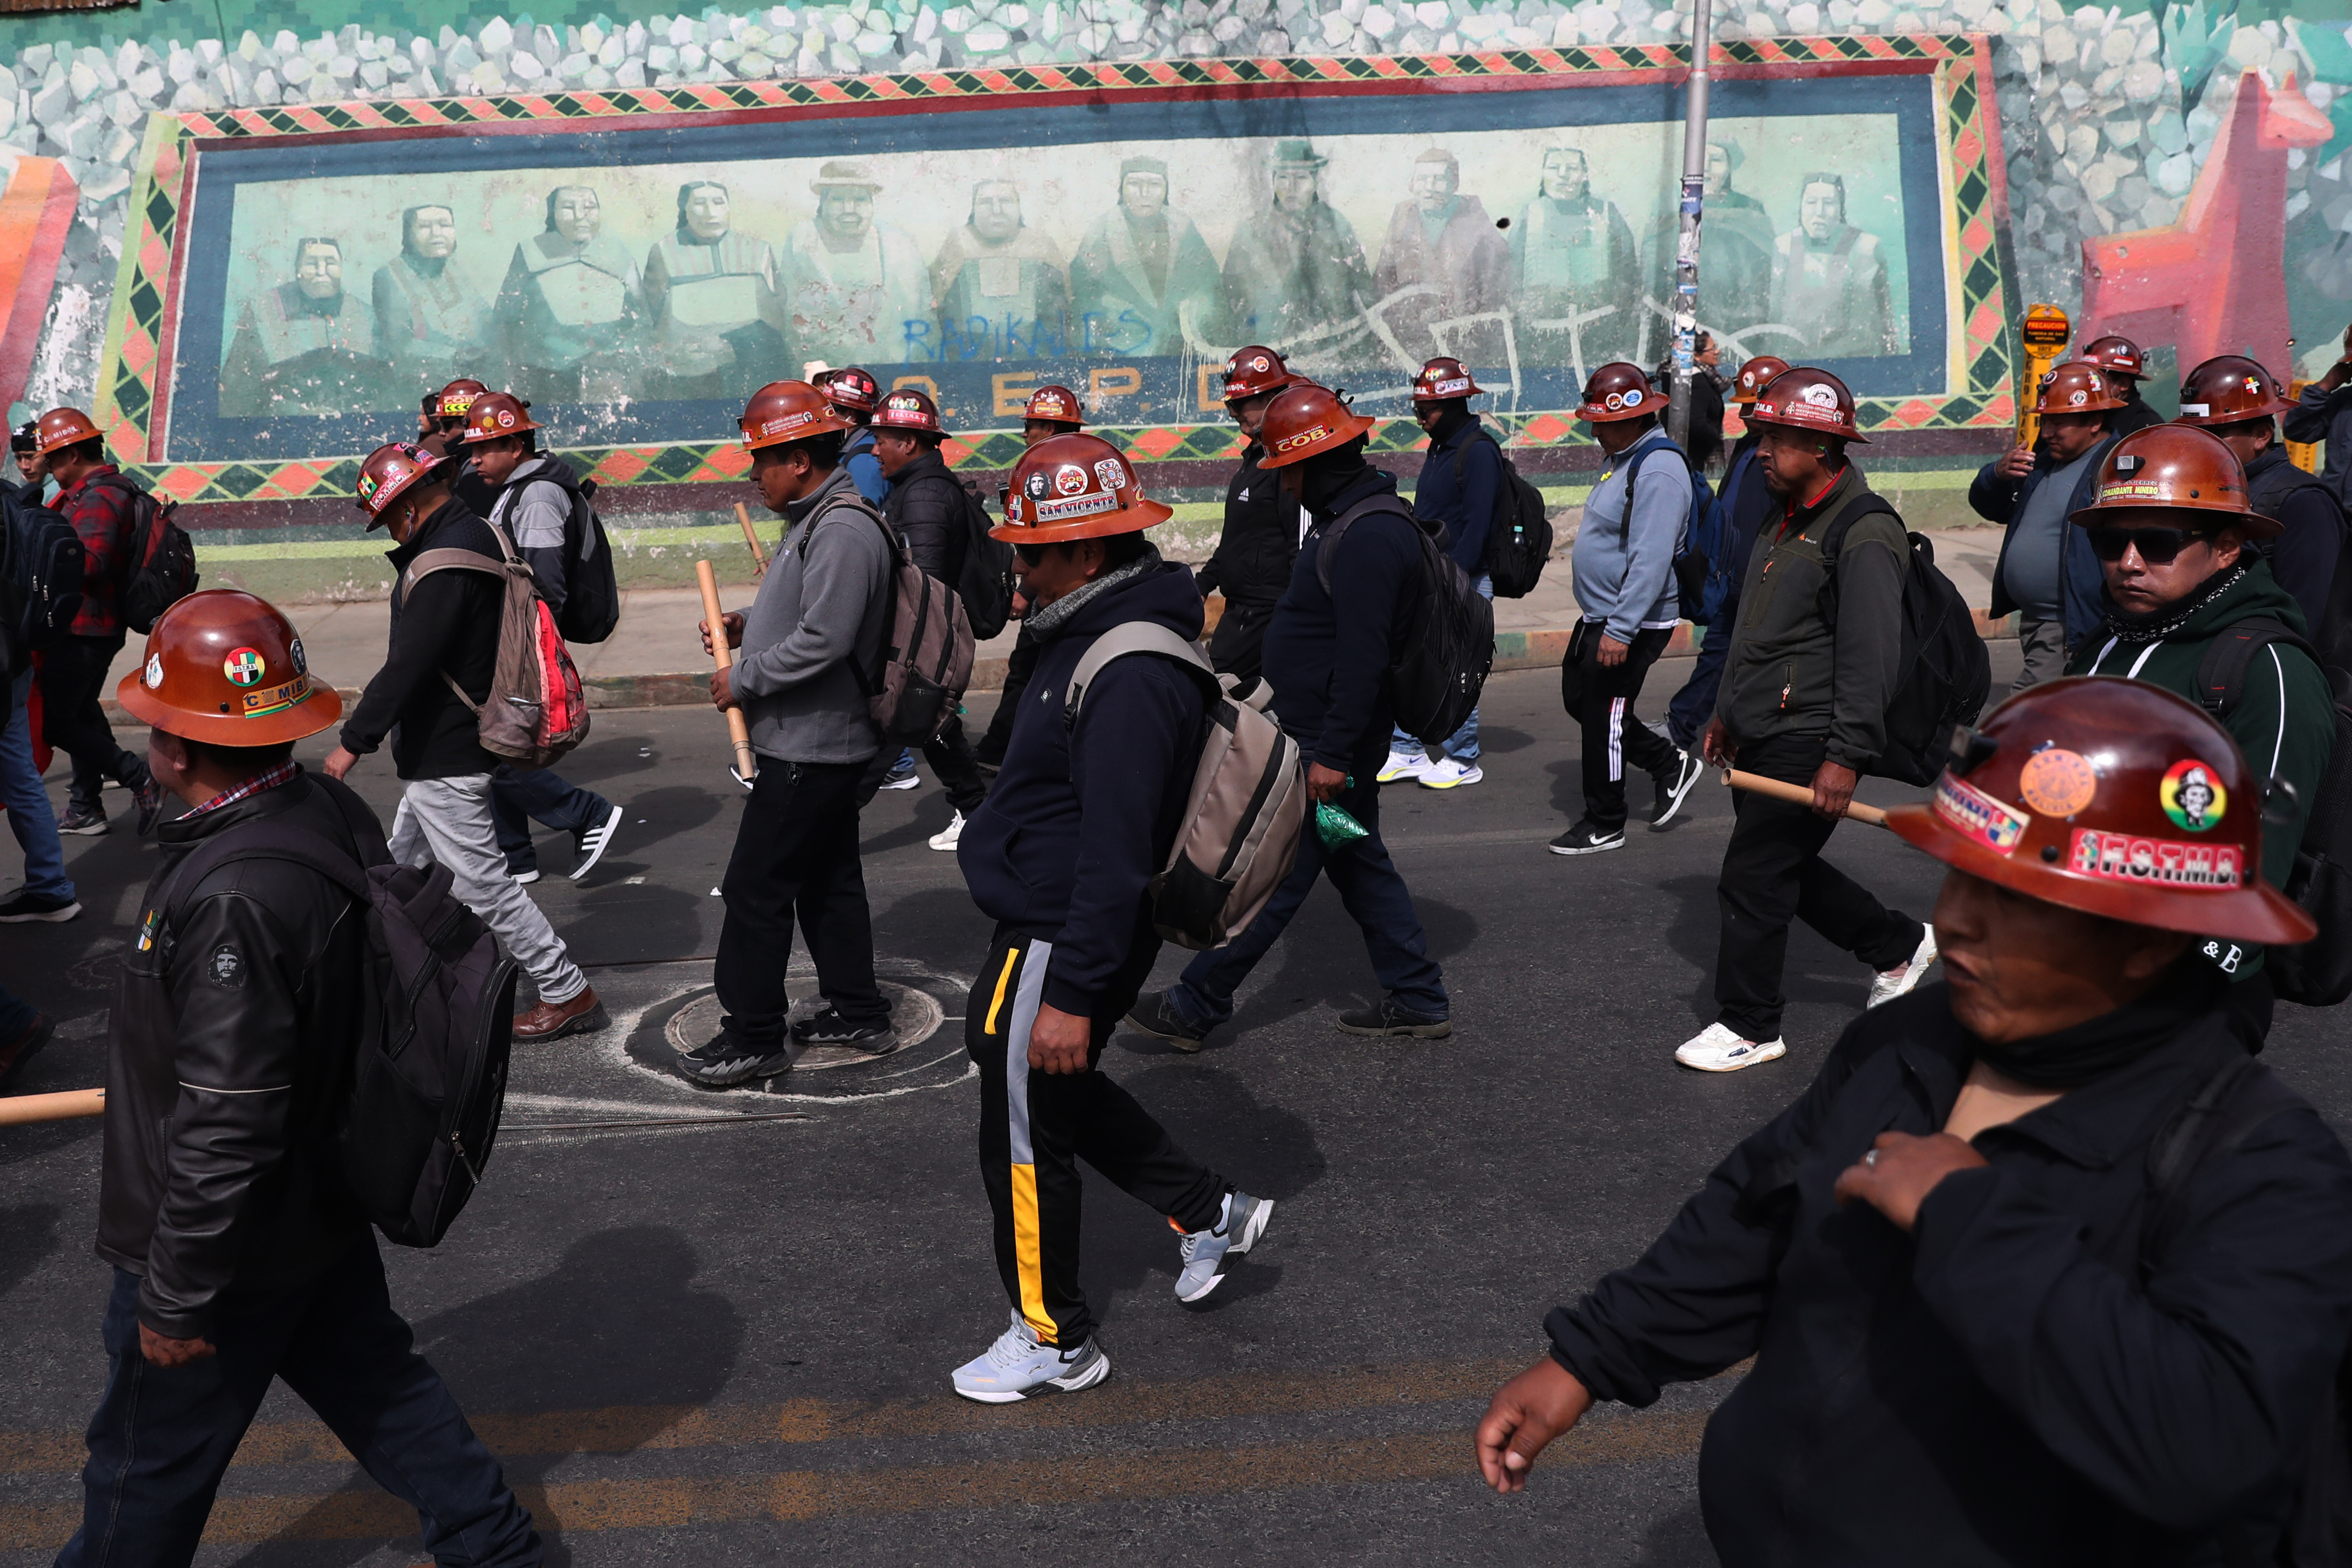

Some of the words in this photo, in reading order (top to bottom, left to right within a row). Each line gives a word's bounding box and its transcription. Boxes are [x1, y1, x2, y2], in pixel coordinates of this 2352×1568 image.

[1278, 429, 1327, 451] COB
[2102, 486, 2133, 498] COMANDANTE
[2134, 486, 2159, 494] MINERO
[1039, 504, 1062, 520] SAN
[1064, 496, 1116, 516] VICENTE
[2101, 834, 2237, 885] F.S.T.M.B.
[2203, 941, 2219, 958] &
[2218, 944, 2242, 973] B
